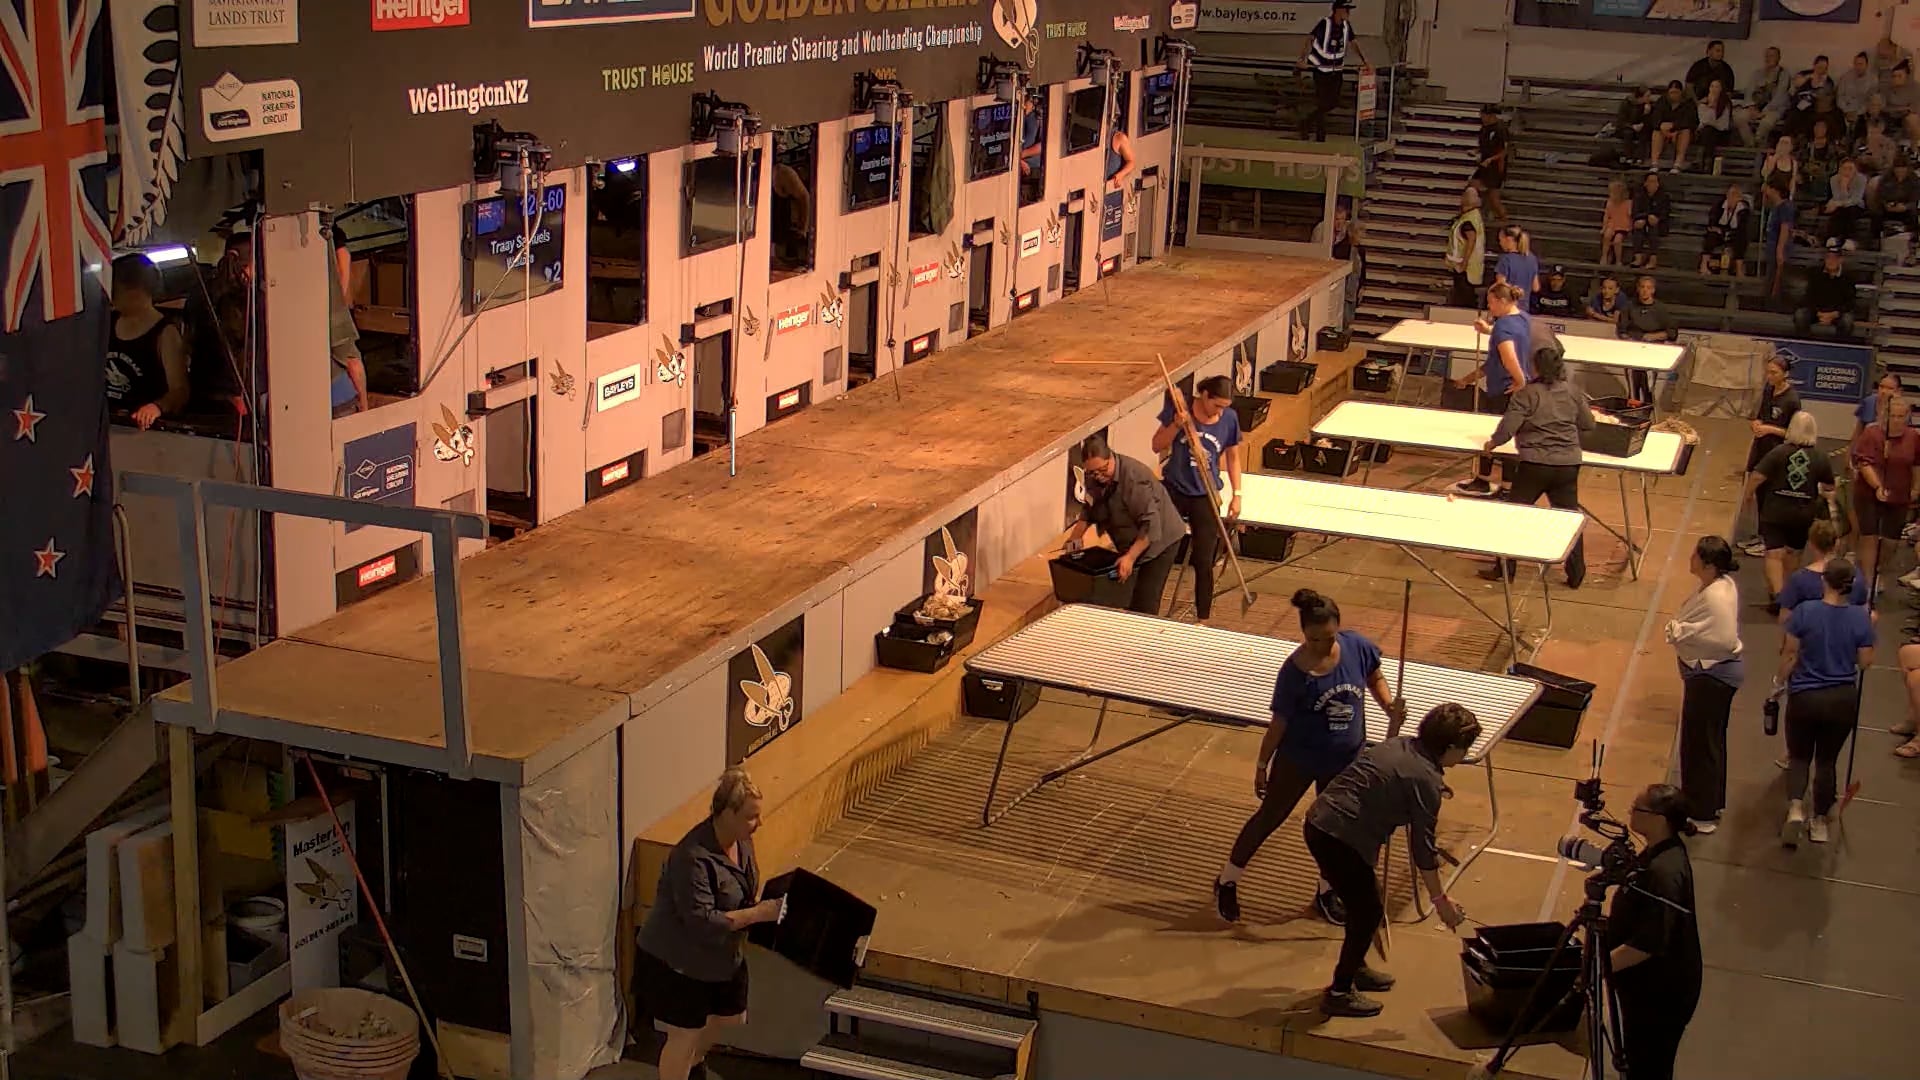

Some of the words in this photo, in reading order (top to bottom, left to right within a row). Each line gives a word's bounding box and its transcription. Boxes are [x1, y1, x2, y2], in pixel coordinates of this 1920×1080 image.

[209, 10, 247, 26] LANDS
[249, 9, 285, 25] TRUST
[703, 42, 739, 73] World
[744, 40, 788, 68] Premier
[791, 35, 839, 62] Shearing
[841, 31, 860, 56] and
[862, 27, 923, 52] Woolhandling
[925, 20, 982, 49] Championship
[602, 66, 647, 92] TRUST
[652, 62, 695, 87] HOUSE
[408, 79, 529, 116] WellingtonNZ
[604, 377, 635, 398] BAYLEYS
[293, 820, 351, 858] Mastertn
